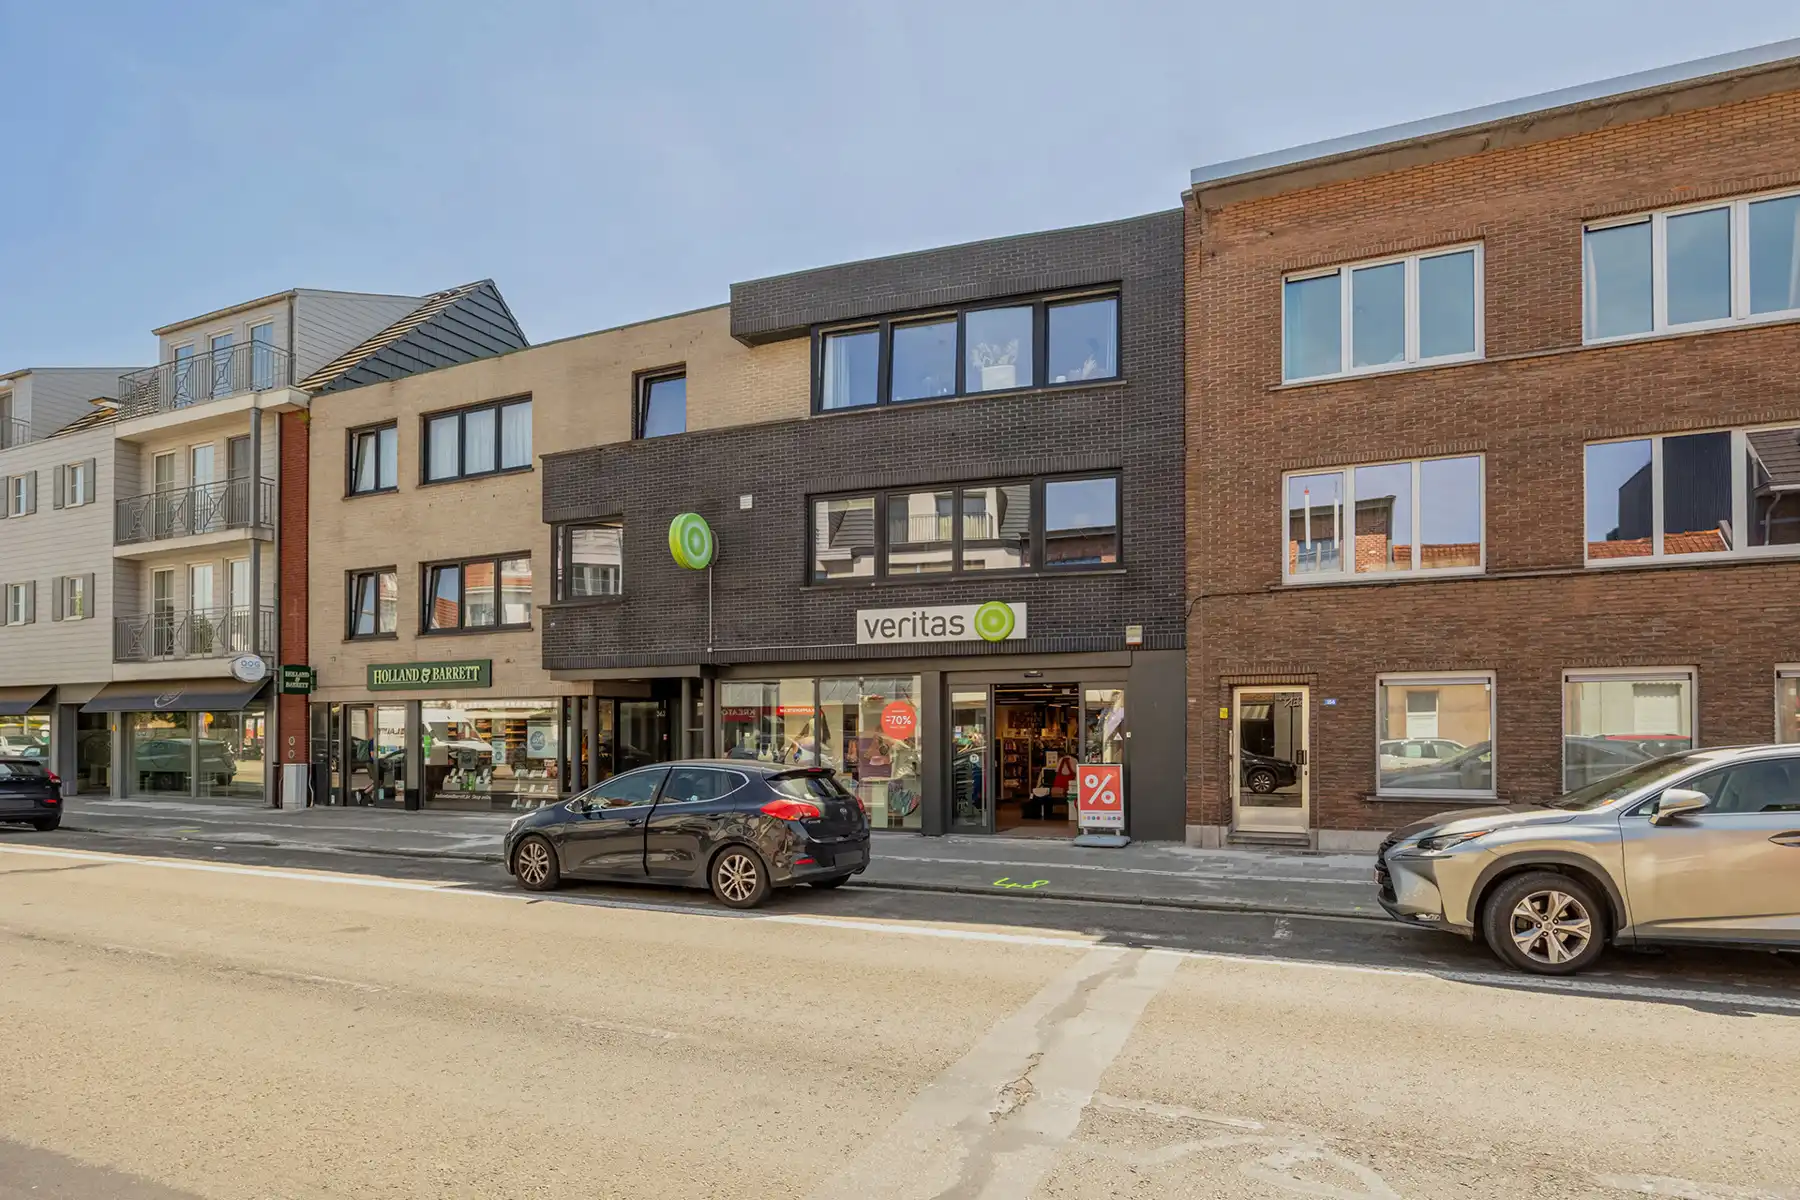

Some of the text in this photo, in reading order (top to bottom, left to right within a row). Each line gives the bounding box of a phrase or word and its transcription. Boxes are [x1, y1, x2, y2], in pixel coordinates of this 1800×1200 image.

[864, 611, 965, 639] veritas
[373, 665, 480, 684] HOLLAND & BARRETT
[1084, 773, 1116, 805] %
